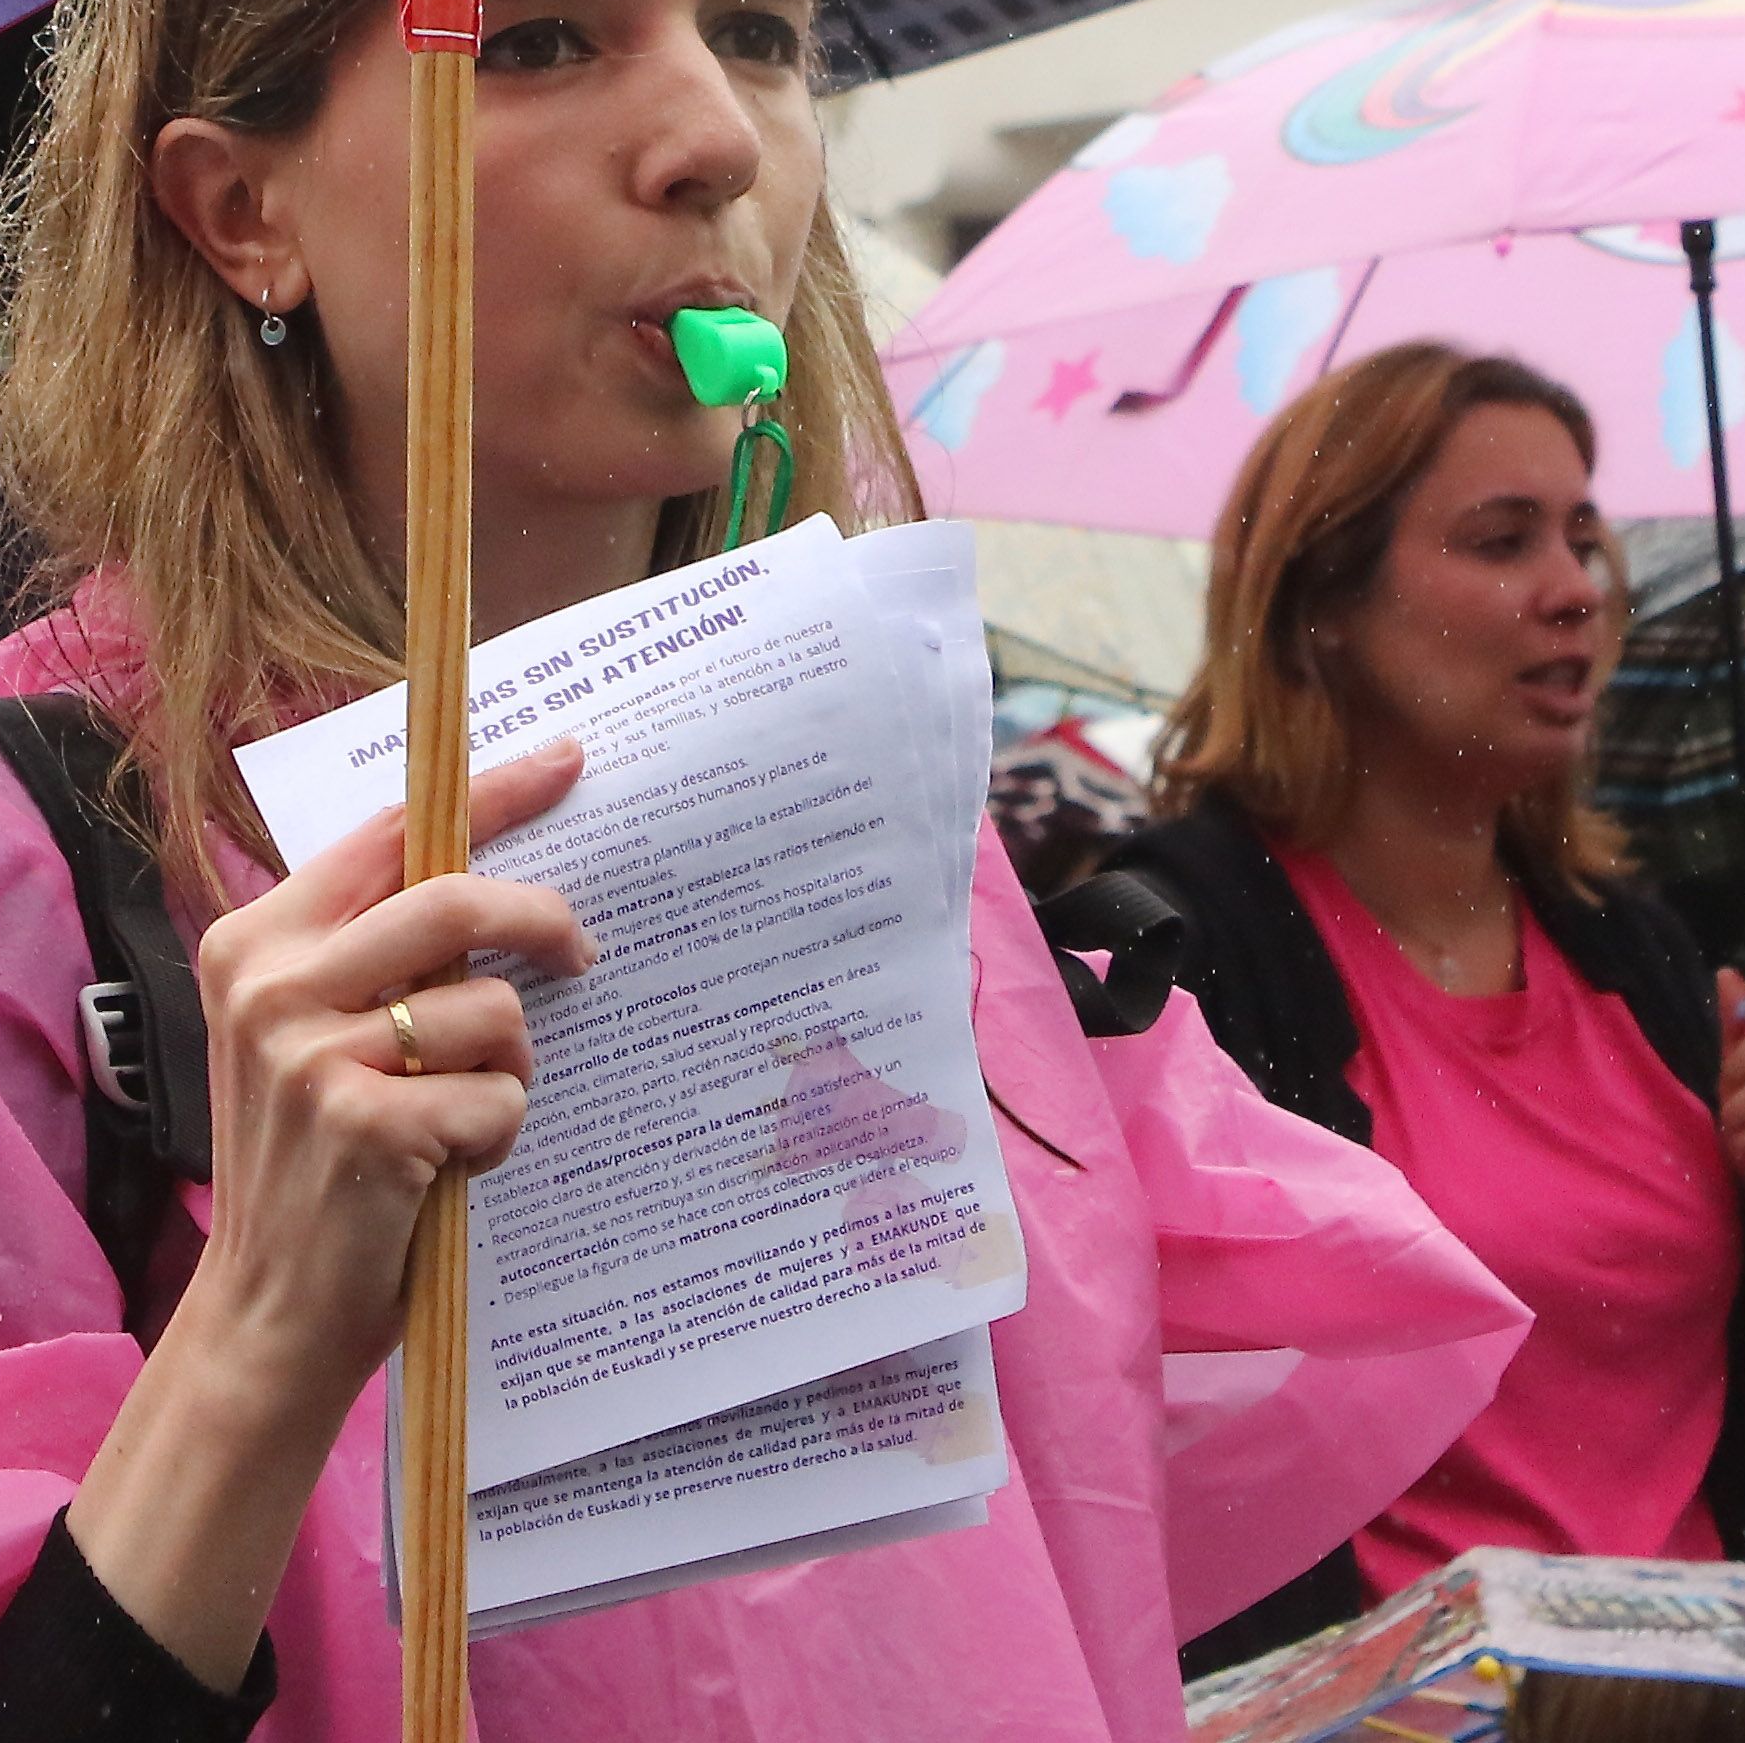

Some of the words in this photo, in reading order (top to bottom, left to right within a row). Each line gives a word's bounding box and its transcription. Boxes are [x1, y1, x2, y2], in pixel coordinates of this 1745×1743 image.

[523, 650, 574, 685] SIN
[578, 559, 770, 657] SUSTITUCIÓN,
[543, 676, 594, 711] SIN
[602, 604, 747, 684] ATENCIÓN!
[589, 680, 676, 726] preocupadas
[678, 668, 700, 687] por
[705, 661, 718, 674] el
[719, 646, 761, 667] futuro
[763, 638, 781, 651] de
[783, 620, 833, 644] nuestra
[469, 843, 487, 862] el
[485, 831, 525, 855] 100%
[524, 823, 545, 841] de
[542, 807, 604, 834] nuestras
[606, 784, 669, 814] ausencias
[680, 758, 748, 788] descansos.
[583, 870, 600, 887] de
[602, 856, 652, 880] nuestra
[754, 815, 767, 826] la
[768, 785, 851, 822] estabilización
[852, 776, 872, 793] del
[581, 909, 613, 928] cada
[616, 889, 674, 917] matrona
[687, 862, 751, 892] establezca
[752, 855, 772, 869] las
[588, 948, 670, 991] garantizando
[671, 944, 683, 958] el
[686, 933, 721, 953] 100%
[722, 923, 738, 941] de
[740, 922, 753, 934] la
[806, 893, 844, 913] todos
[844, 885, 866, 900] los
[866, 876, 892, 893] días
[531, 1008, 613, 1047] mecanismos
[626, 983, 697, 1018] protocolos
[726, 955, 780, 984] protejan
[781, 939, 830, 961] nuestra
[832, 923, 866, 945] salud
[868, 913, 903, 932] como
[542, 1053, 611, 1085] desarrollo
[612, 1046, 629, 1060] de
[631, 1033, 669, 1054] todas
[672, 1013, 731, 1040] nuestras
[733, 981, 825, 1019] competencias
[483, 1178, 550, 1208] Establezca
[552, 1136, 674, 1185] agendas/procesos
[675, 1125, 707, 1147] para
[708, 1119, 722, 1131] la
[724, 1097, 789, 1126] demanda
[789, 1091, 808, 1104] no
[884, 1059, 902, 1073] un
[490, 1333, 523, 1352] Ante
[527, 1321, 557, 1338] esta
[633, 1288, 658, 1304] nos
[723, 1238, 806, 1274] movilizando
[822, 1214, 883, 1244] pedimos
[895, 1201, 917, 1216] las
[920, 1182, 975, 1208] mujeres
[576, 1267, 590, 1280] la
[632, 1248, 648, 1261] de
[651, 1239, 677, 1255] una
[678, 1219, 738, 1245] matrona
[740, 1188, 831, 1225] coordinadora
[898, 1156, 911, 1172] el
[634, 1310, 655, 1324] las
[662, 1279, 748, 1315] asociaciones
[754, 1271, 771, 1284] de
[778, 1250, 834, 1277] mujeres
[871, 1210, 949, 1249] EMAKUNDE
[500, 1369, 543, 1390] exijan
[576, 1353, 592, 1366] se
[595, 1328, 665, 1359] mantenga
[667, 1322, 682, 1335] la
[686, 1301, 745, 1329] atención
[748, 1294, 766, 1308] de
[769, 1274, 819, 1301] calidad
[821, 1266, 853, 1287] para
[856, 1254, 886, 1272] más
[888, 1248, 906, 1261] de
[908, 1242, 922, 1255] la
[925, 1225, 967, 1249] mitad
[968, 1219, 986, 1235] de
[504, 1398, 518, 1410] la
[520, 1375, 589, 1409] población
[591, 1365, 609, 1382] de
[611, 1346, 666, 1375] Euskadi
[679, 1340, 694, 1353] se
[697, 1319, 757, 1351] preserve
[759, 1301, 813, 1326] nuestro
[815, 1282, 871, 1307] derecho
[884, 1269, 899, 1284] la
[900, 1256, 941, 1280] salud.
